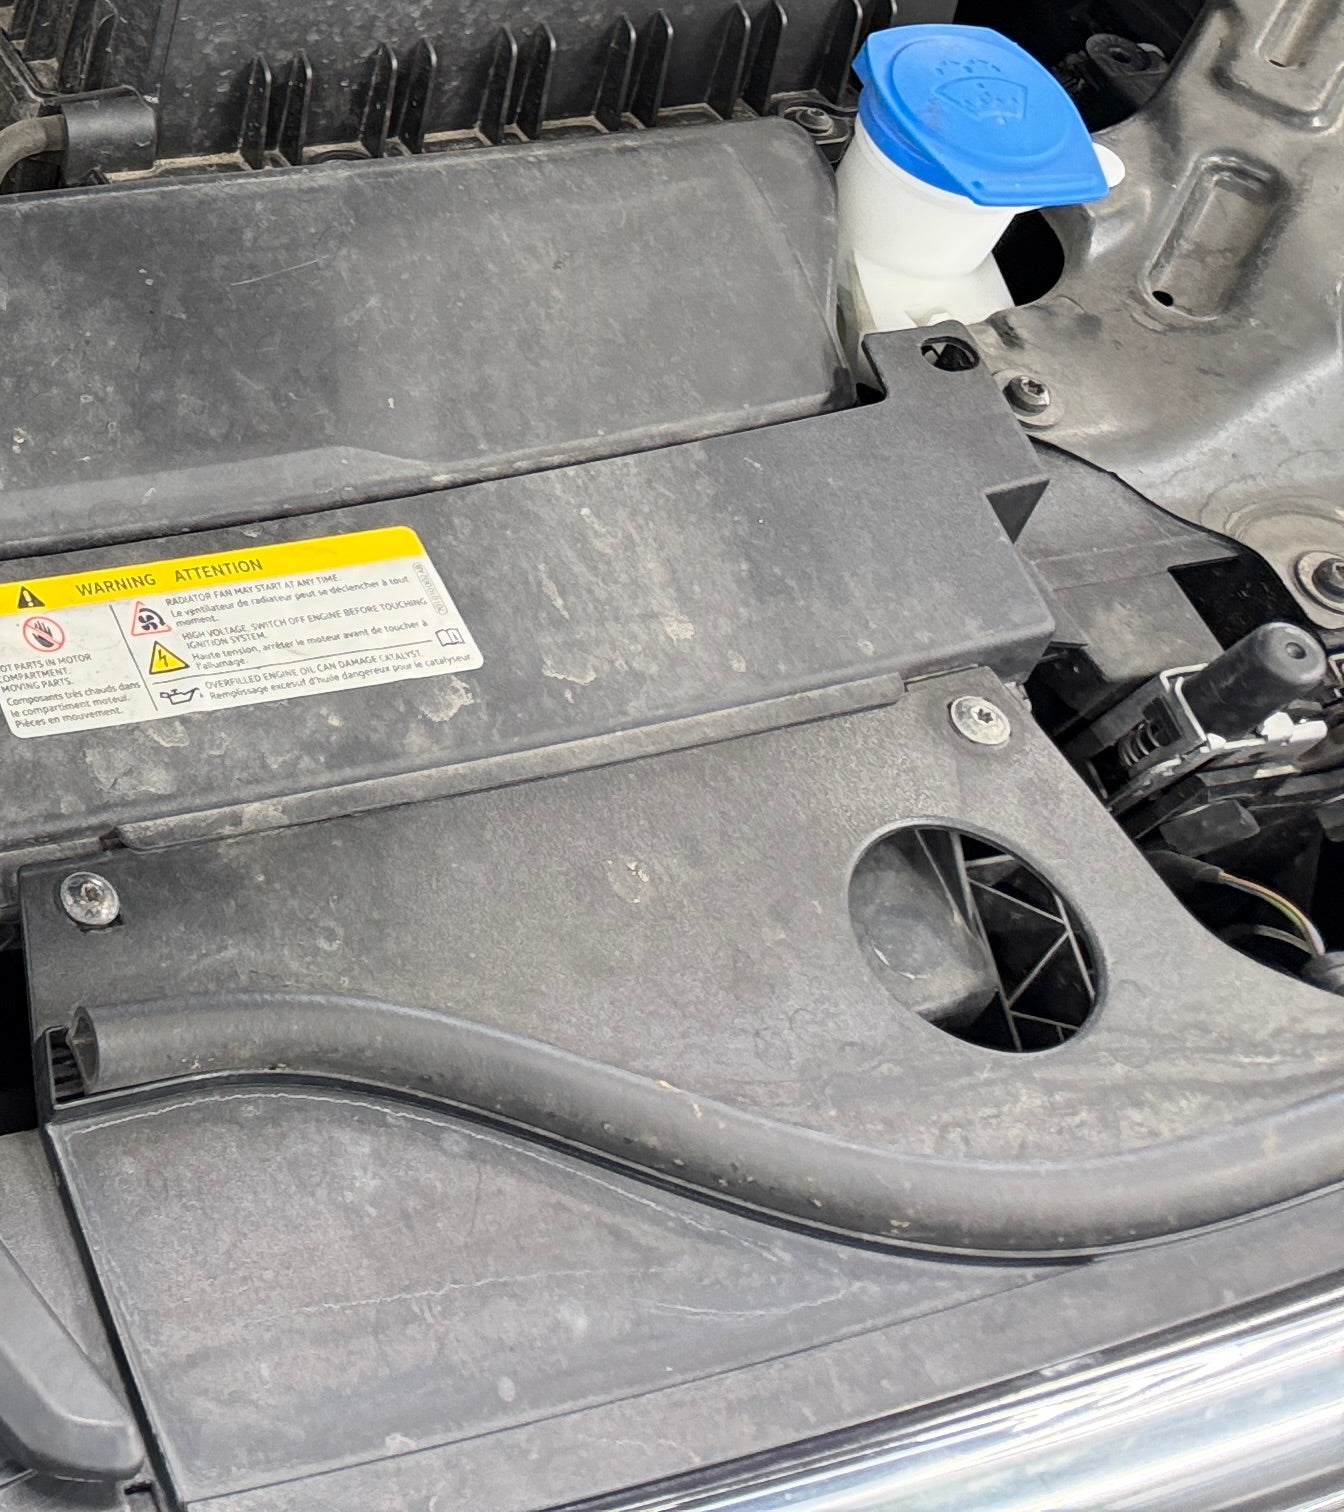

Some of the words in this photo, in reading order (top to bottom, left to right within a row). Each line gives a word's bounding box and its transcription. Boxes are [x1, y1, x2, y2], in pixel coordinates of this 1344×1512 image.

[75, 574, 156, 598] WARNING
[175, 559, 263, 582] ATTENTION
[165, 593, 212, 606] RADIATOR
[214, 589, 232, 598] FAN
[234, 585, 253, 594] MAY
[256, 582, 281, 592] START
[297, 578, 314, 587] ANY
[171, 610, 182, 618] Le
[184, 603, 234, 616] ventilateur
[237, 599, 249, 607] de
[251, 595, 292, 605] radiateur
[295, 589, 317, 601] peut
[330, 581, 379, 593] déclencher
[390, 576, 409, 584] tout
[182, 631, 205, 640] HIGH
[251, 618, 287, 630] SWITCH
[288, 616, 304, 624] OFF
[308, 610, 342, 623] ENGINE
[344, 606, 379, 617] BEFORE
[380, 598, 427, 611] TOUCHING
[186, 637, 228, 649] IGNITION
[192, 652, 221, 661] Haute
[296, 637, 305, 645] le
[307, 634, 341, 644] moteur
[343, 629, 369, 638] avant
[371, 626, 382, 634] de
[385, 621, 419, 632] toucher
[15, 660, 43, 670] PARTS
[57, 654, 92, 664] MOTOR
[205, 676, 261, 689] OVERFILLED
[263, 669, 298, 680] ENGINE
[300, 666, 316, 674] OIL
[317, 662, 337, 672] CAN
[339, 657, 377, 668] DAMAGE
[1, 683, 40, 693] MOVING
[7, 692, 63, 706] Composants
[64, 690, 82, 699] très
[85, 684, 117, 696] chauds
[119, 681, 140, 691] dans
[210, 686, 268, 700] Remplissage
[271, 680, 306, 690] excessif
[309, 674, 340, 685] d'huile
[342, 666, 390, 679] dangereux
[393, 663, 411, 672] pour
[15, 717, 46, 728] Pièces
[48, 716, 60, 724] en
[22, 701, 91, 716] compartiment
